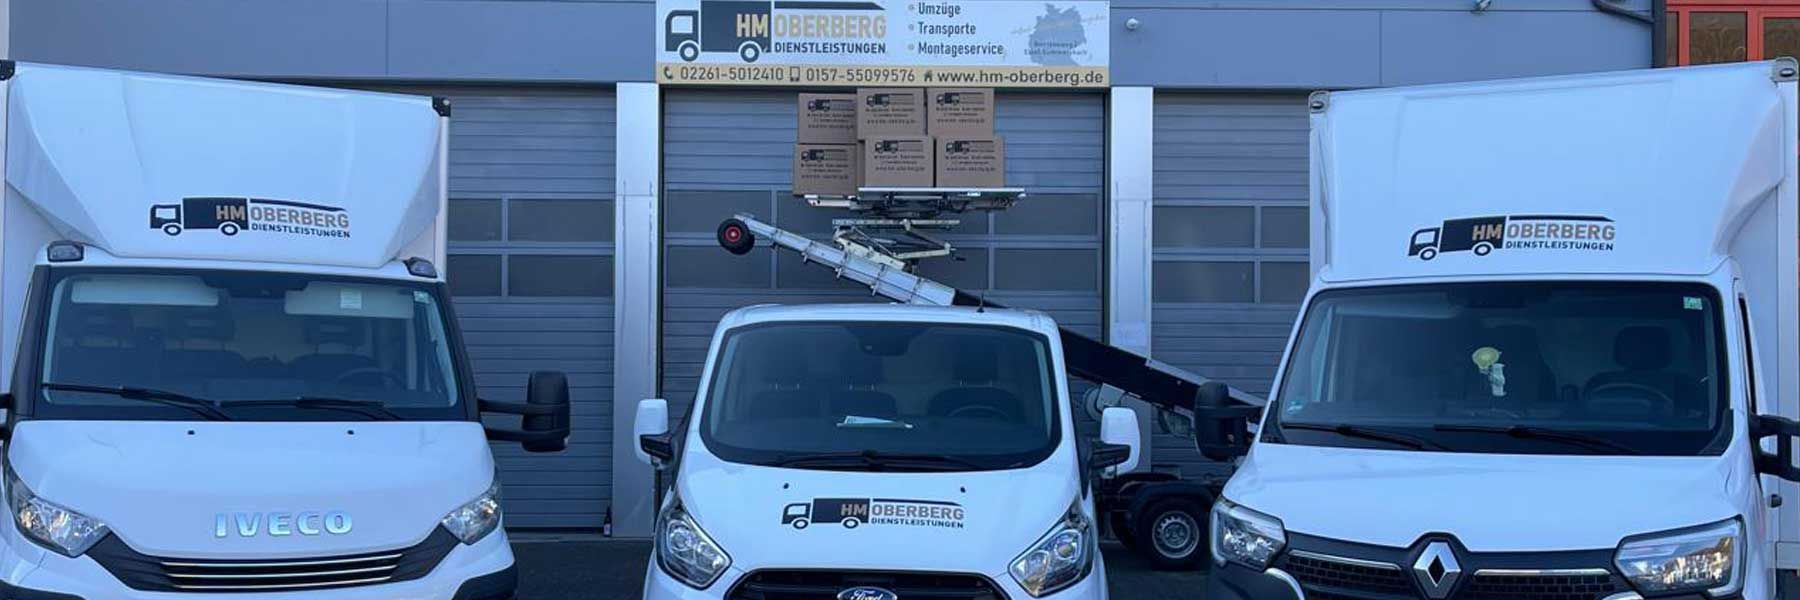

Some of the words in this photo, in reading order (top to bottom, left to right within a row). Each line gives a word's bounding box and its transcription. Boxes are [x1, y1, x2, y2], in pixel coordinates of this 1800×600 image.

[918, 2, 961, 17] Umzüge
[736, 13, 769, 38] HM
[774, 15, 887, 38] OBERBERG
[918, 22, 976, 37] Transporte
[774, 42, 887, 54] DIENSTLEISTUNGEN
[918, 42, 1004, 57] Montageservice
[680, 67, 784, 81] 02261-5012410
[806, 68, 915, 82] 0157-55099576
[938, 70, 1104, 85] www.hm-oberberg.de
[215, 205, 246, 221] HM
[250, 206, 350, 228] OBERBERG
[251, 223, 351, 238] DIENSTLEISTUNGEN
[1472, 224, 1503, 241] HM
[1506, 223, 1616, 240] OBERBERG
[1505, 240, 1614, 251] DIENSTLEISTUNGEN
[840, 503, 867, 516] HM
[871, 504, 965, 520] OBERBERG
[215, 511, 353, 538] IVECO
[871, 517, 964, 529] DIENSTLEISTUNGEN
